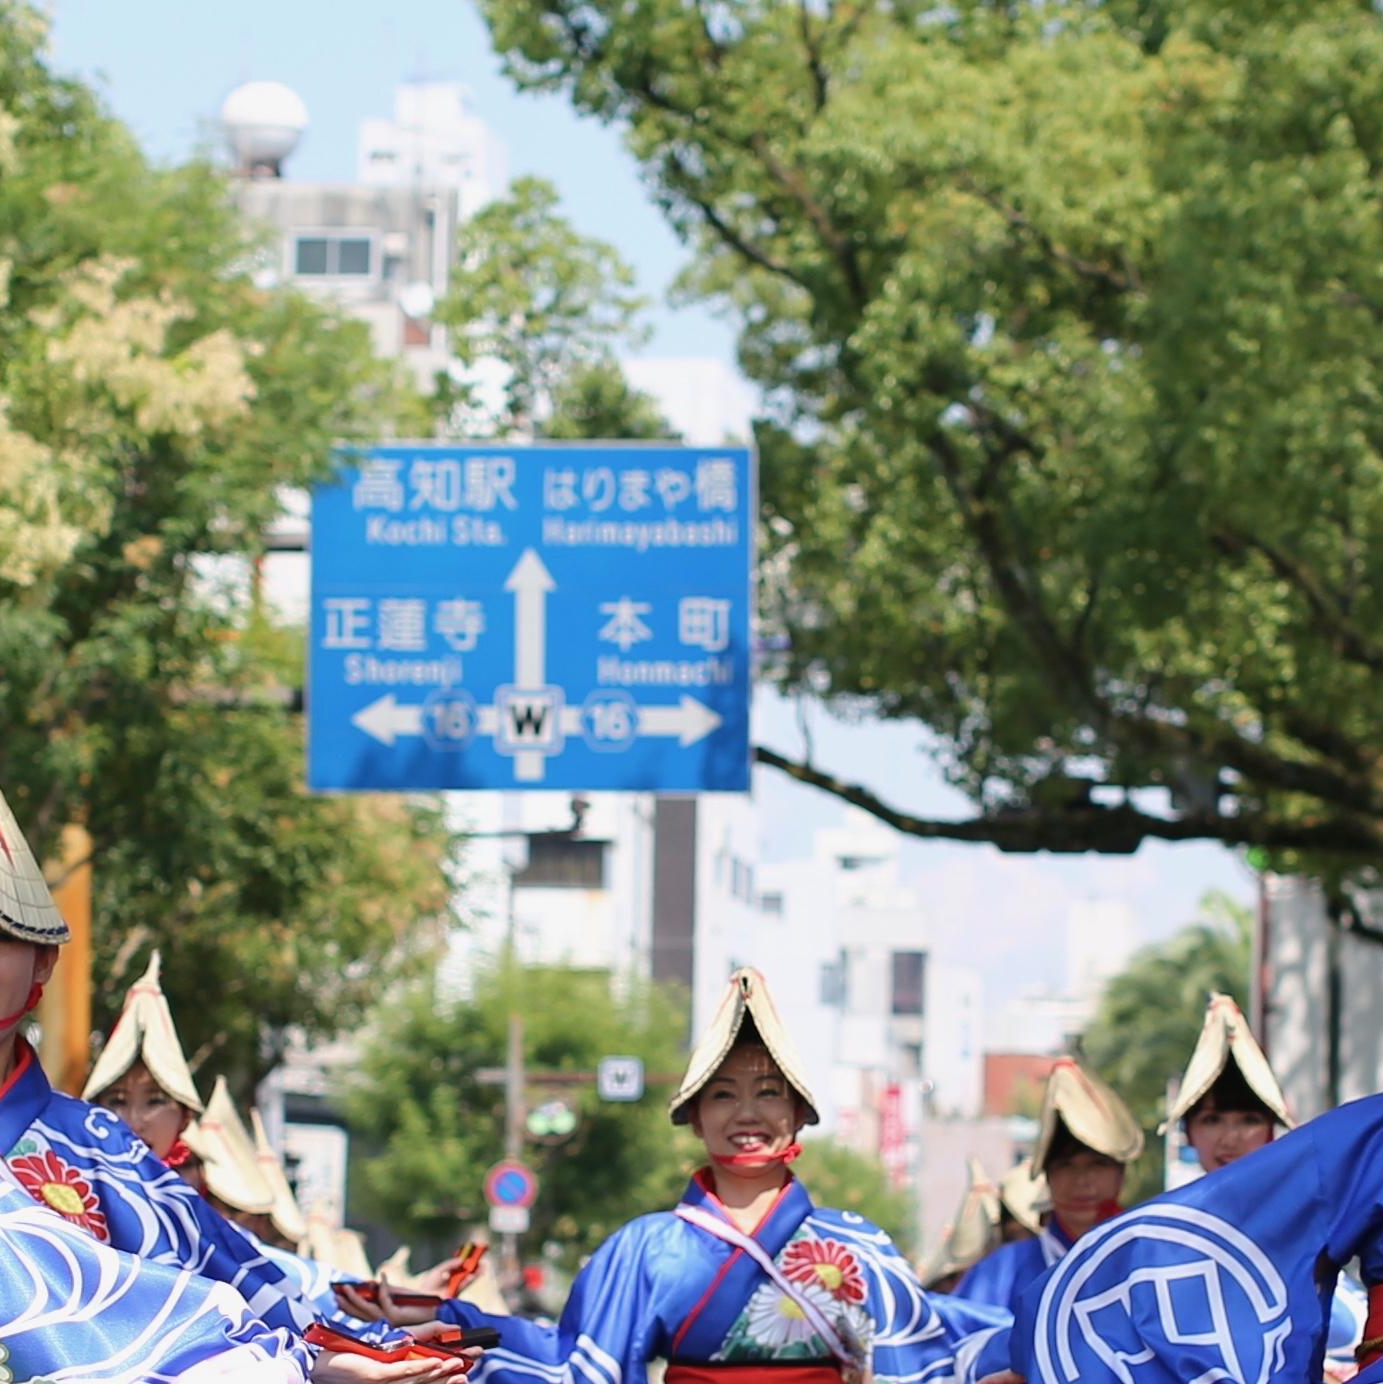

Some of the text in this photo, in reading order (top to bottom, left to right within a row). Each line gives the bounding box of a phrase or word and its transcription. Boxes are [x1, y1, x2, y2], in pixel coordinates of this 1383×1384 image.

[354, 457, 517, 512] 高知駅
[543, 459, 738, 512] はりまや橋
[367, 517, 507, 545] Kochi Sta.
[543, 517, 738, 551] Harimayabashi
[323, 598, 485, 651] 正蓮寺
[597, 596, 732, 652] 本町
[344, 653, 463, 692] Shorenji
[597, 656, 733, 686] Honmachi
[509, 704, 548, 737] W
[591, 702, 625, 738] 16
